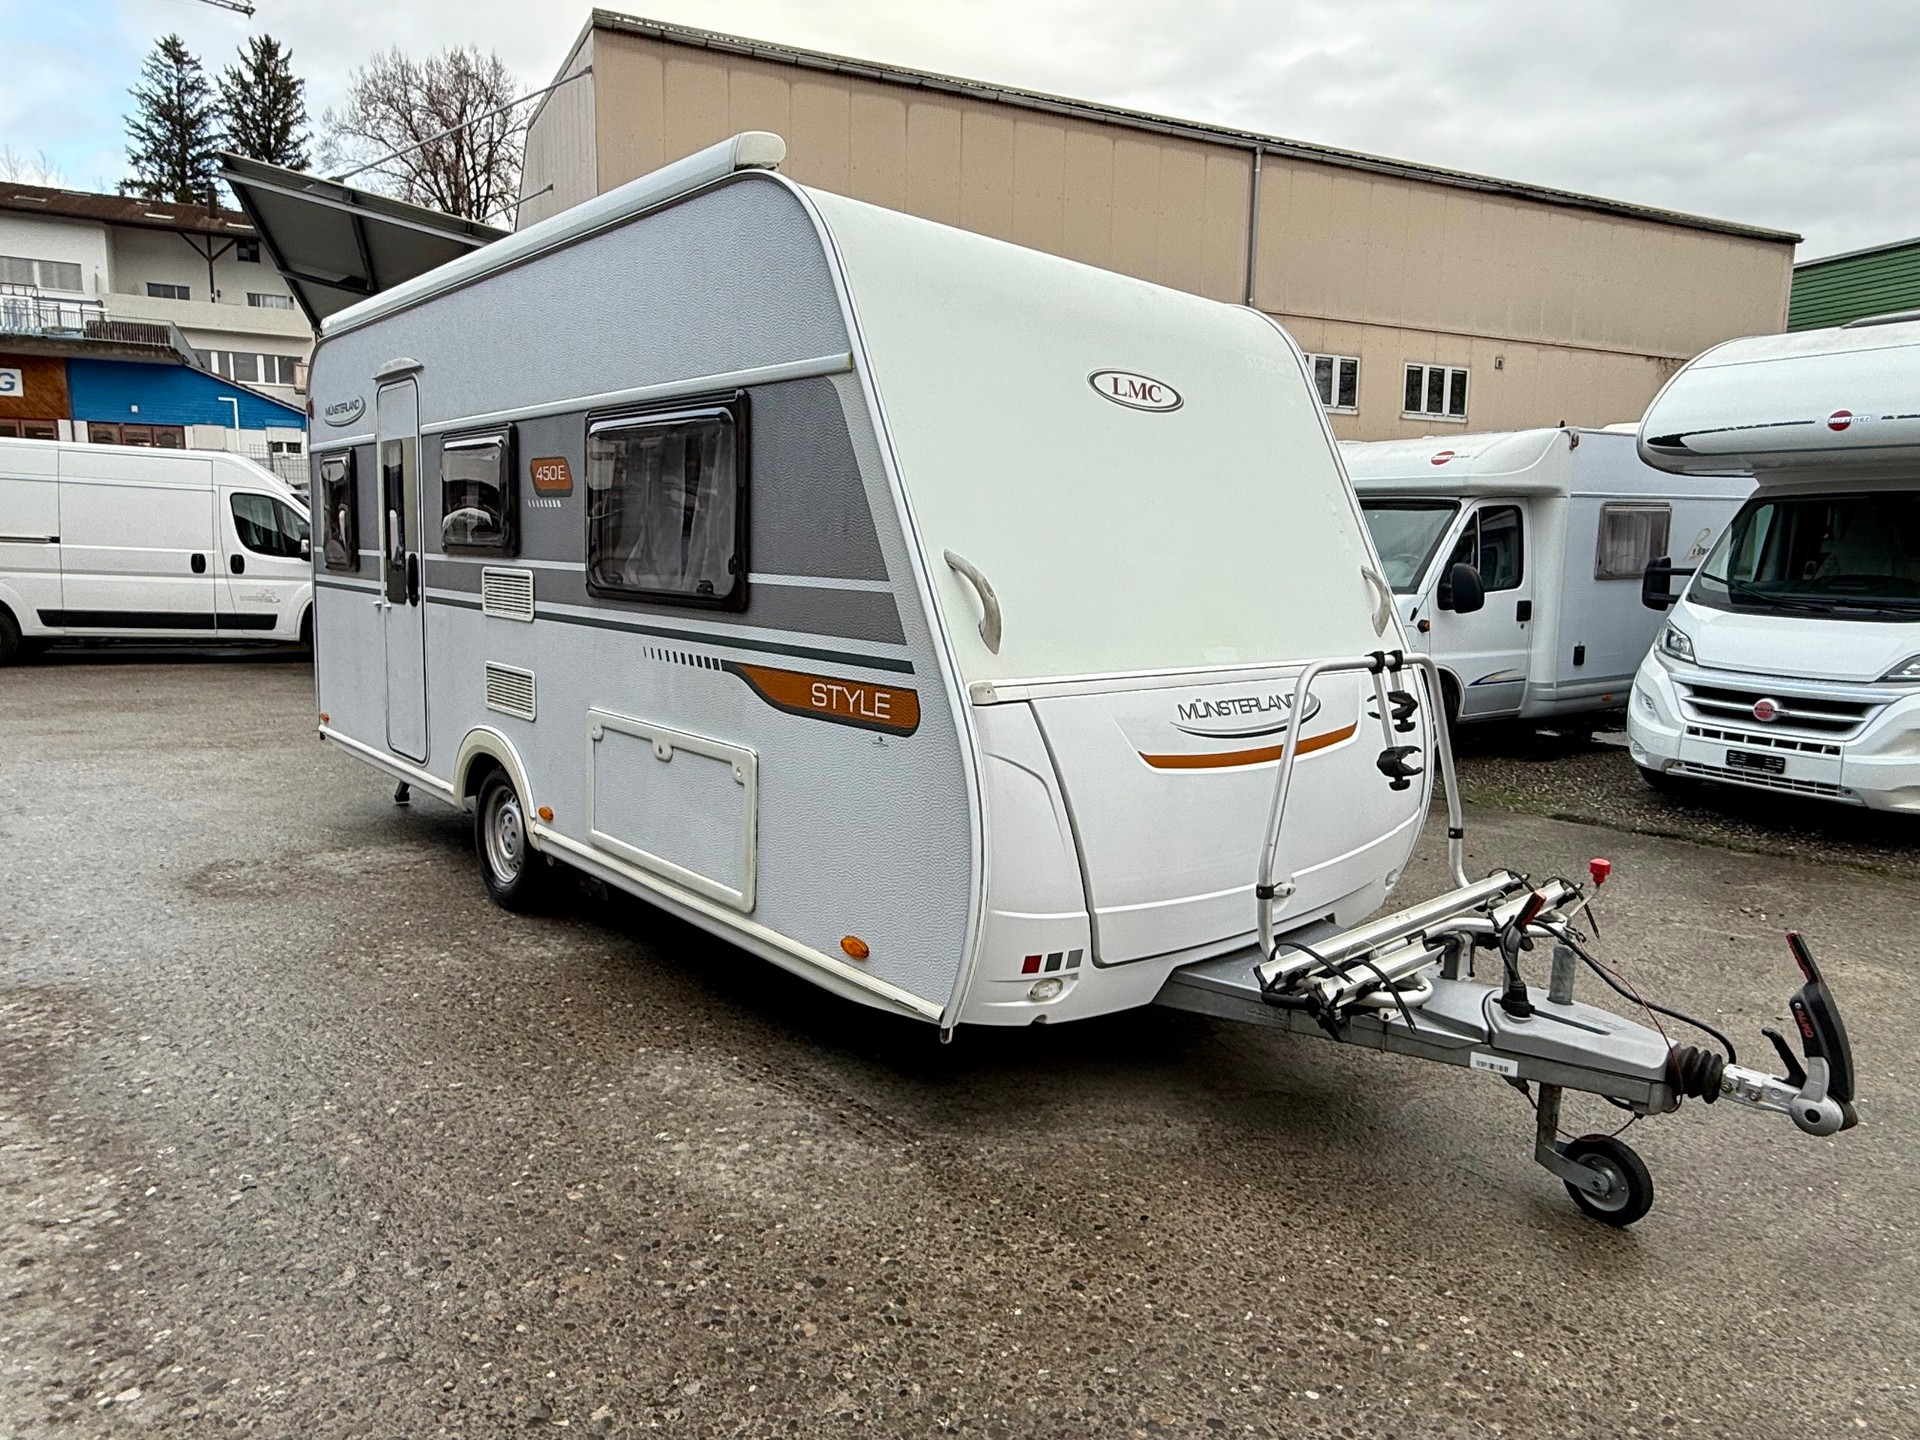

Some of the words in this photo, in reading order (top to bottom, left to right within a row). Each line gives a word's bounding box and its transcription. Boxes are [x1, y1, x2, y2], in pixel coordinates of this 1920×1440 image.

[1111, 376, 1162, 403] LMC
[536, 465, 566, 481] 450E
[811, 682, 891, 719] STYLE
